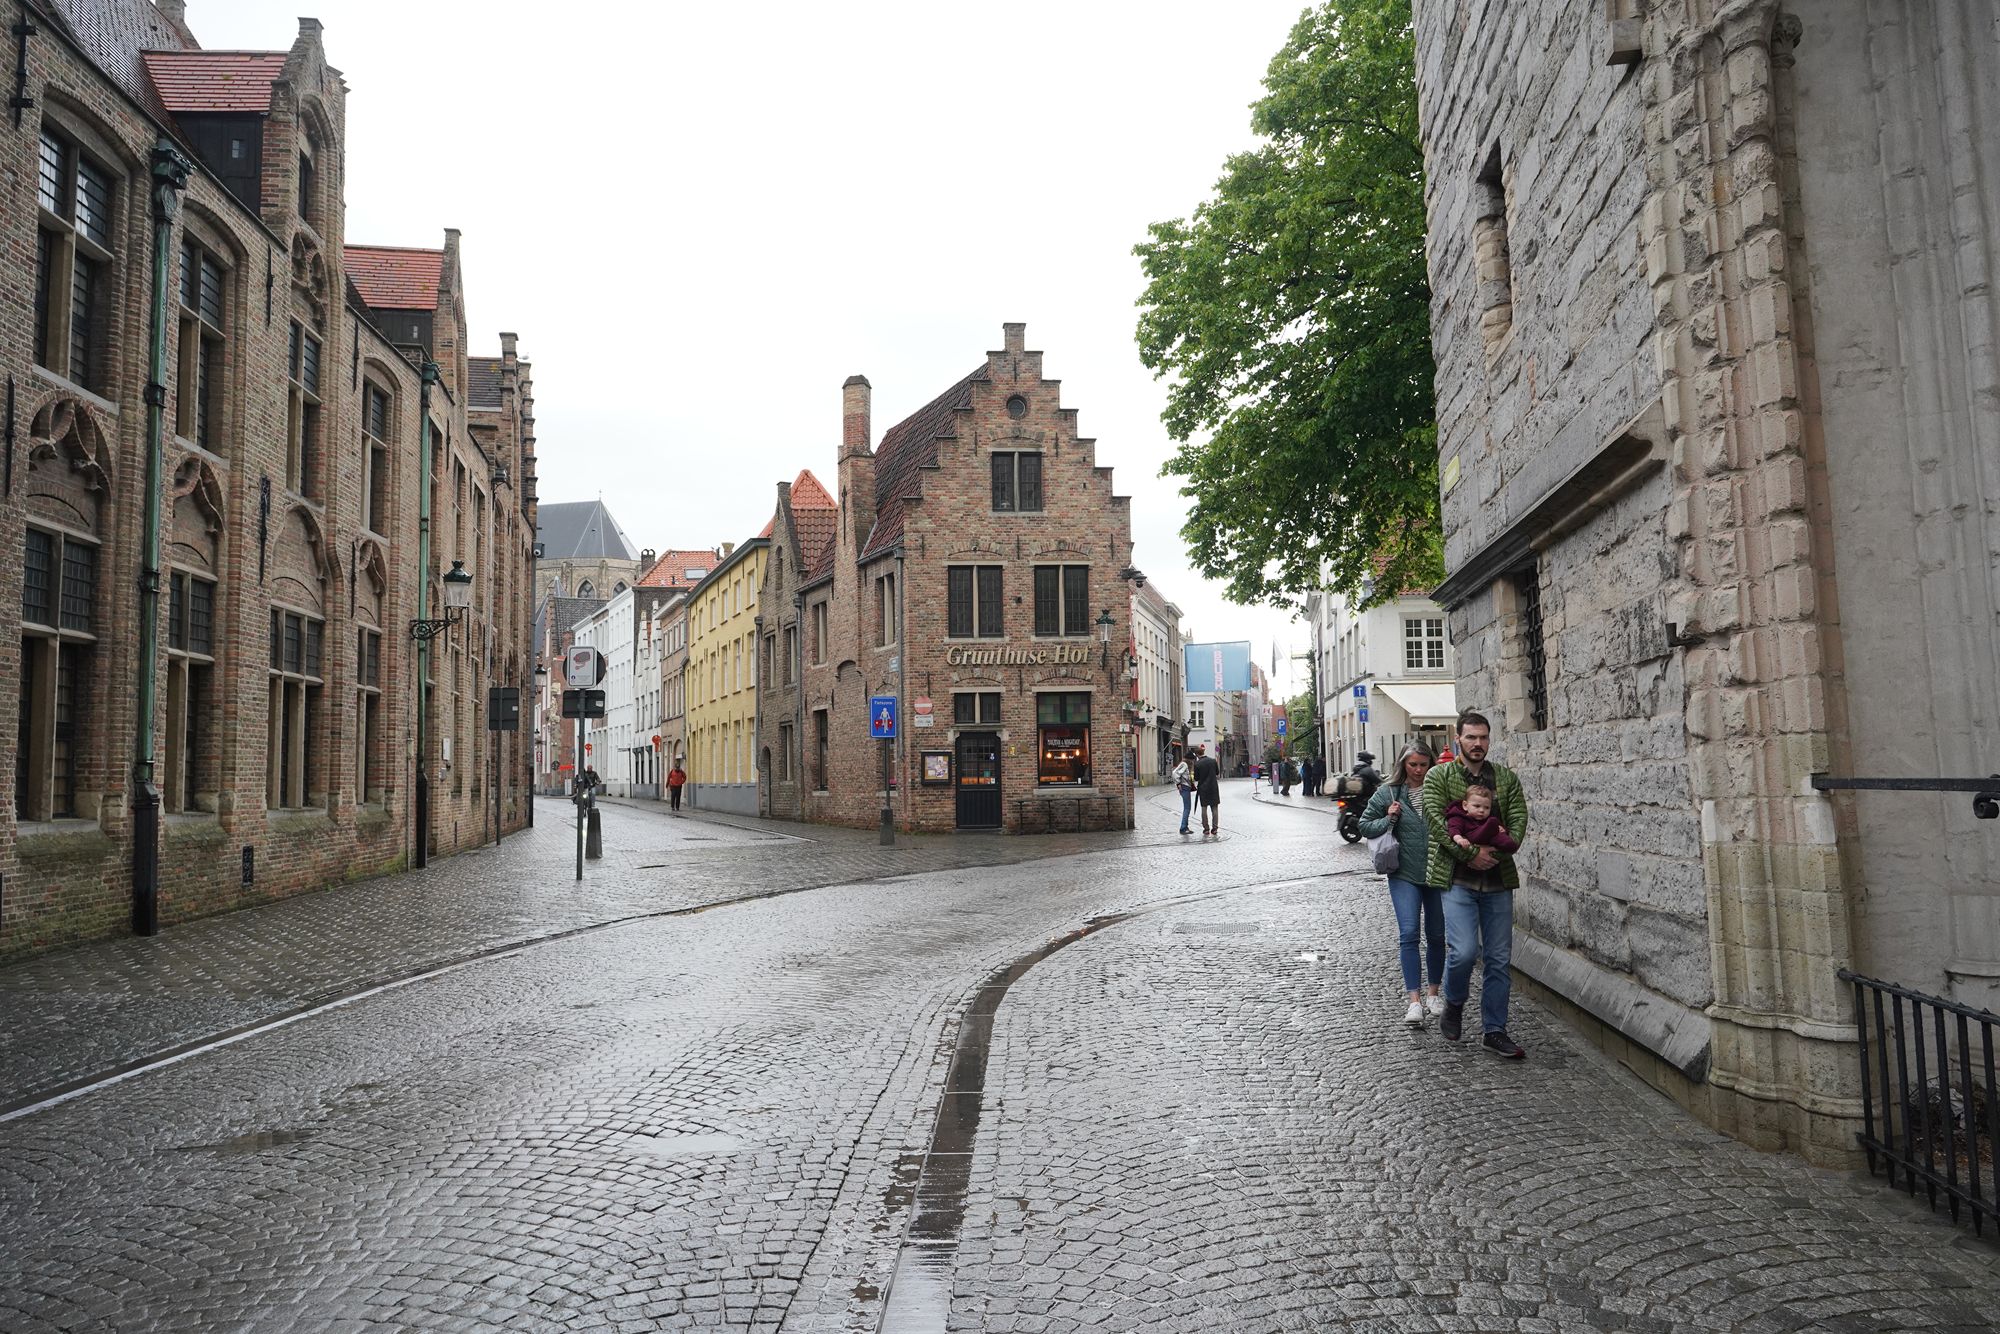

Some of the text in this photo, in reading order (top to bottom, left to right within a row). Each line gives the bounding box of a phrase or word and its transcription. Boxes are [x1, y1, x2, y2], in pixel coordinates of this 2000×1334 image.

[946, 644, 1092, 665] Gruuthuse Hof
[1278, 720, 1286, 730] P
